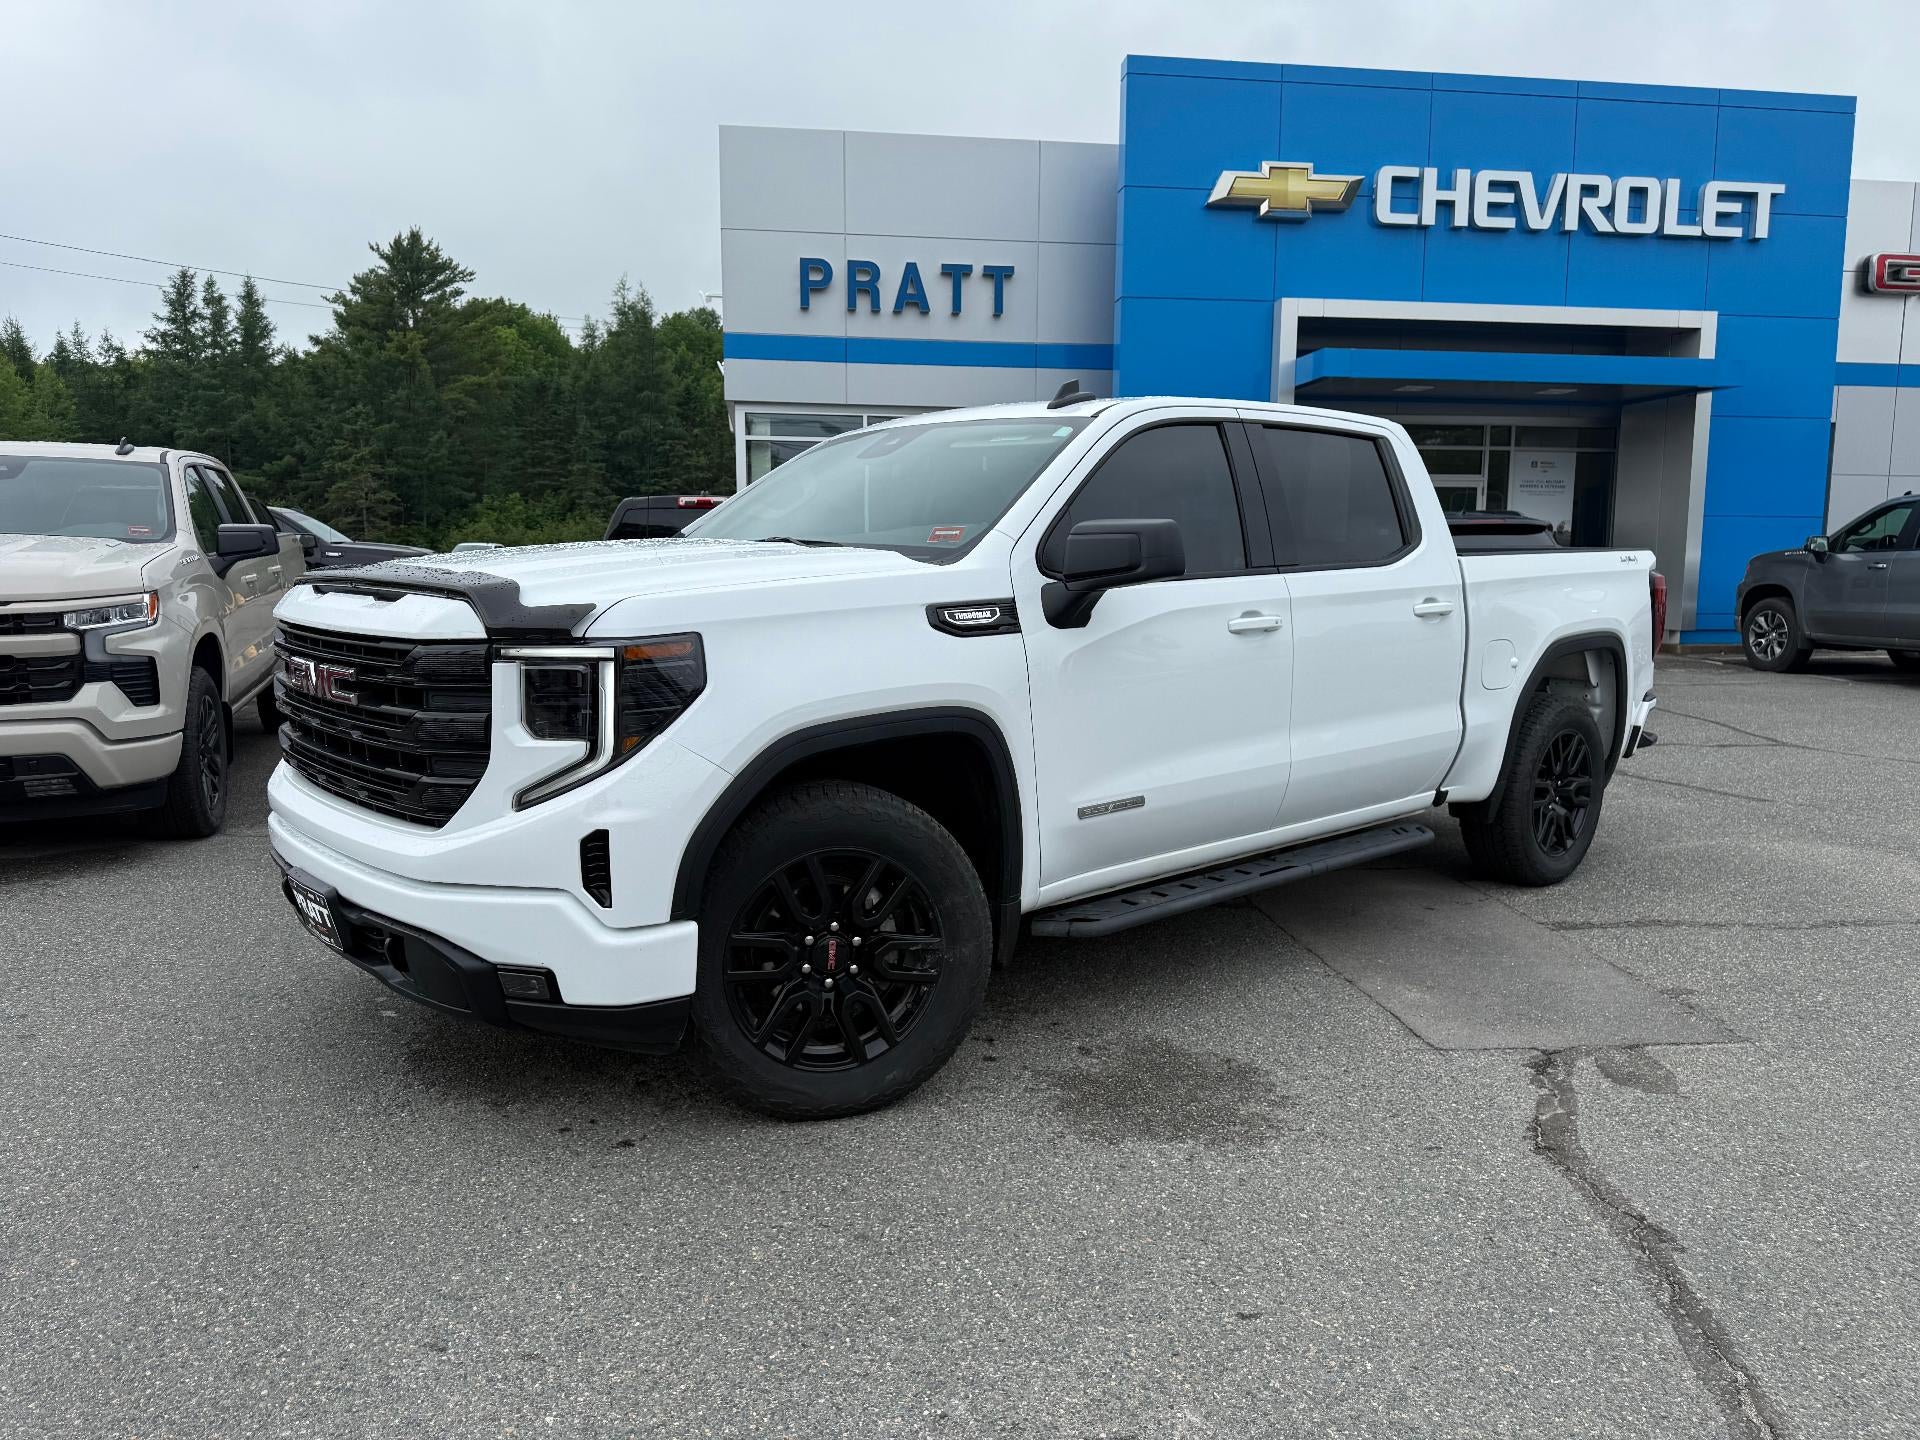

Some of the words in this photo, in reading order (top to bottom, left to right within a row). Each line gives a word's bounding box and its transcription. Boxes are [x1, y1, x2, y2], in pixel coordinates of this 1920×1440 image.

[1373, 165, 1786, 240] CHEVROLET
[799, 257, 1015, 317] PRATT
[288, 656, 359, 706] GMC
